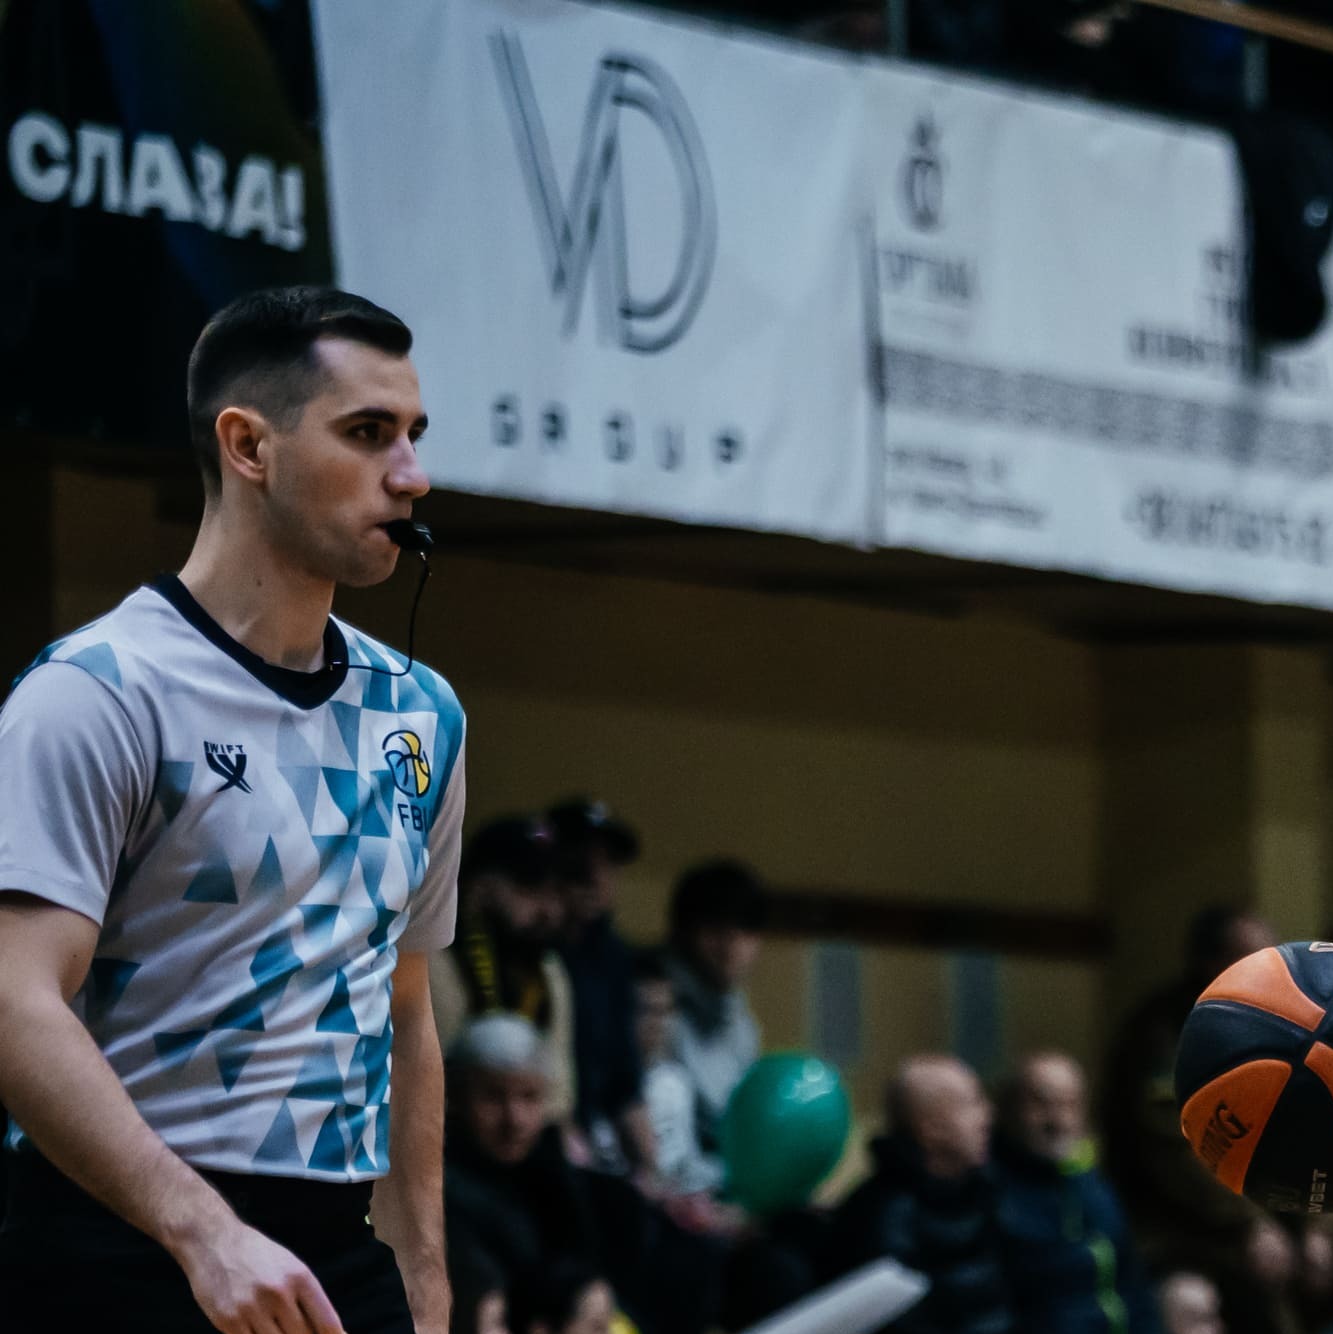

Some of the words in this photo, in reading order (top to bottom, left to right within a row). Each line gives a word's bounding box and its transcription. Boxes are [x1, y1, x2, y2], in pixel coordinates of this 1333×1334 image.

[8, 110, 306, 252] СЛАВА!
[490, 392, 747, 471] GROUP
[204, 741, 244, 754] SWIFT
[1307, 1168, 1328, 1213] VBET
